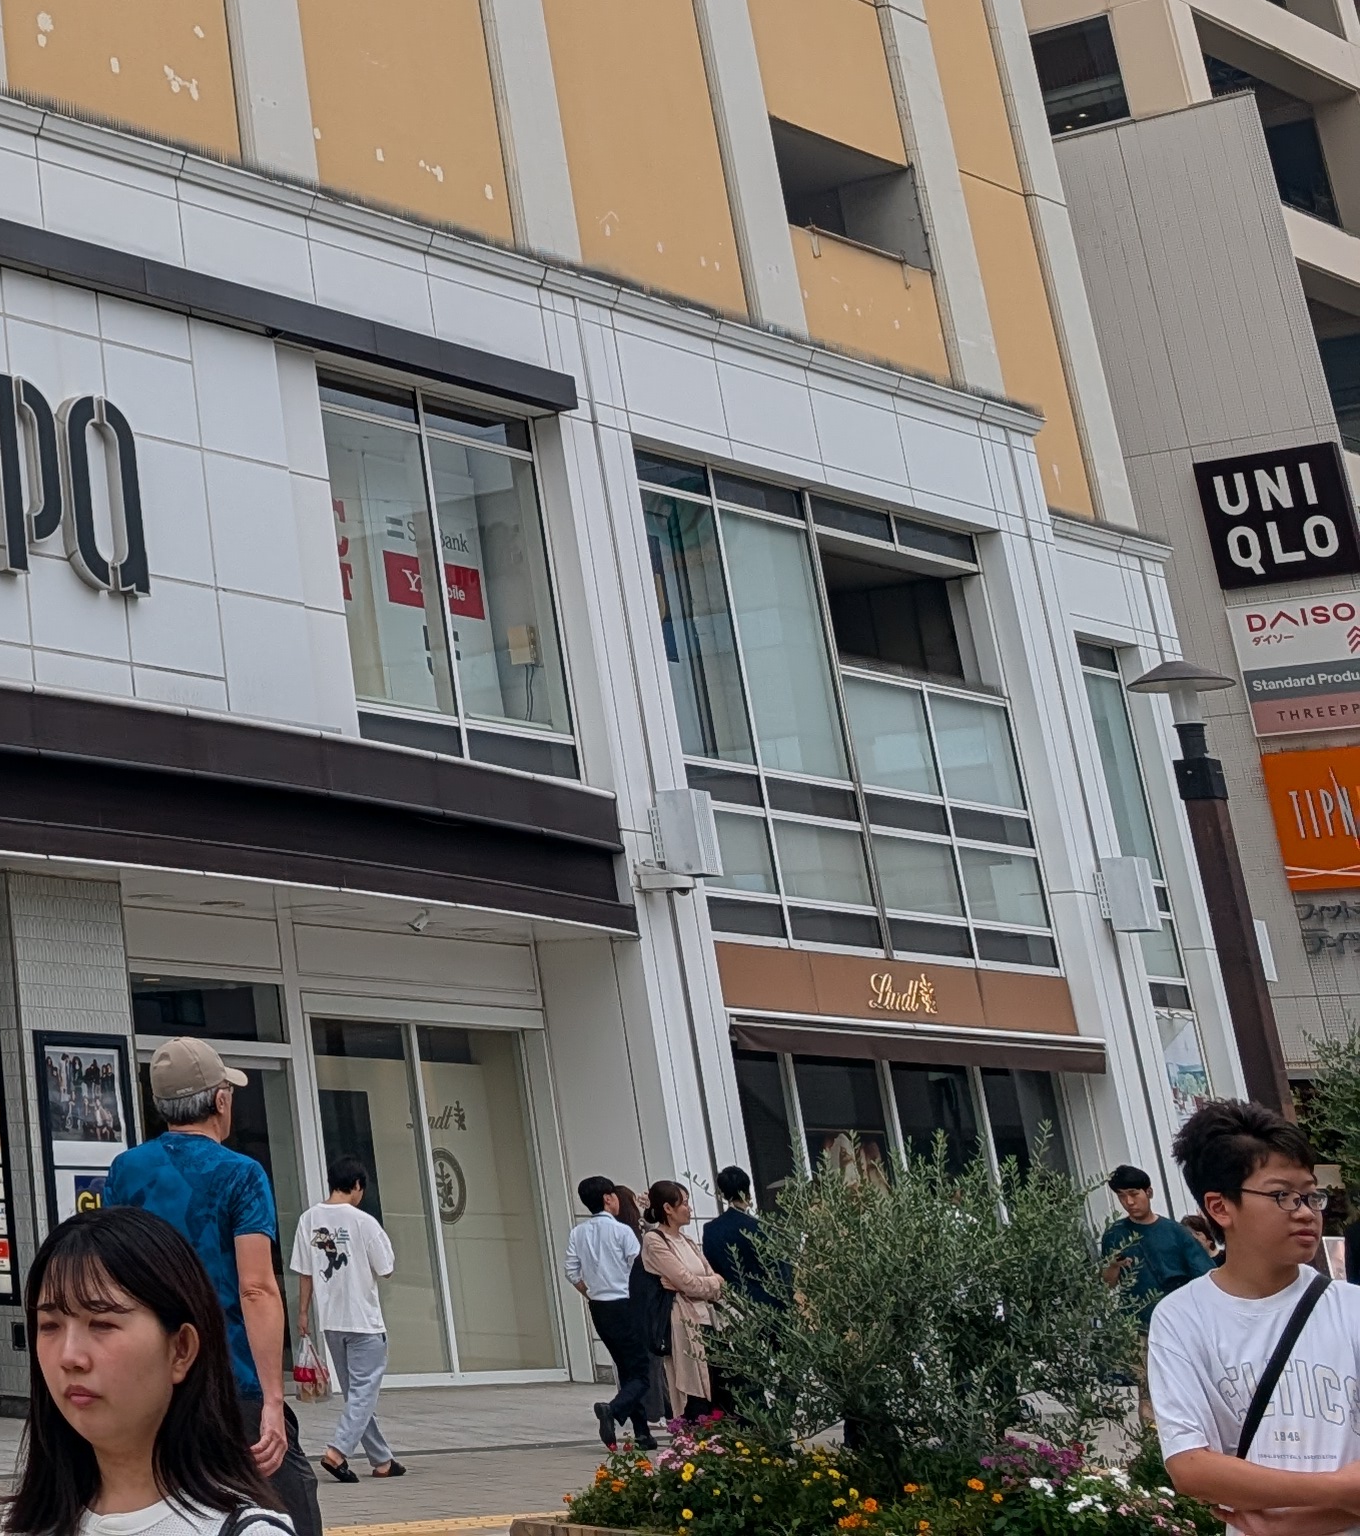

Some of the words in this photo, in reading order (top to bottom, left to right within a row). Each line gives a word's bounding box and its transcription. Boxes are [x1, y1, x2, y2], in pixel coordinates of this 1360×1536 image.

[1212, 462, 1318, 516] UNI
[1226, 515, 1339, 575] QLO
[1246, 602, 1356, 633] DAISO
[1252, 633, 1294, 646] ダイソー
[1252, 674, 1315, 691] Standard
